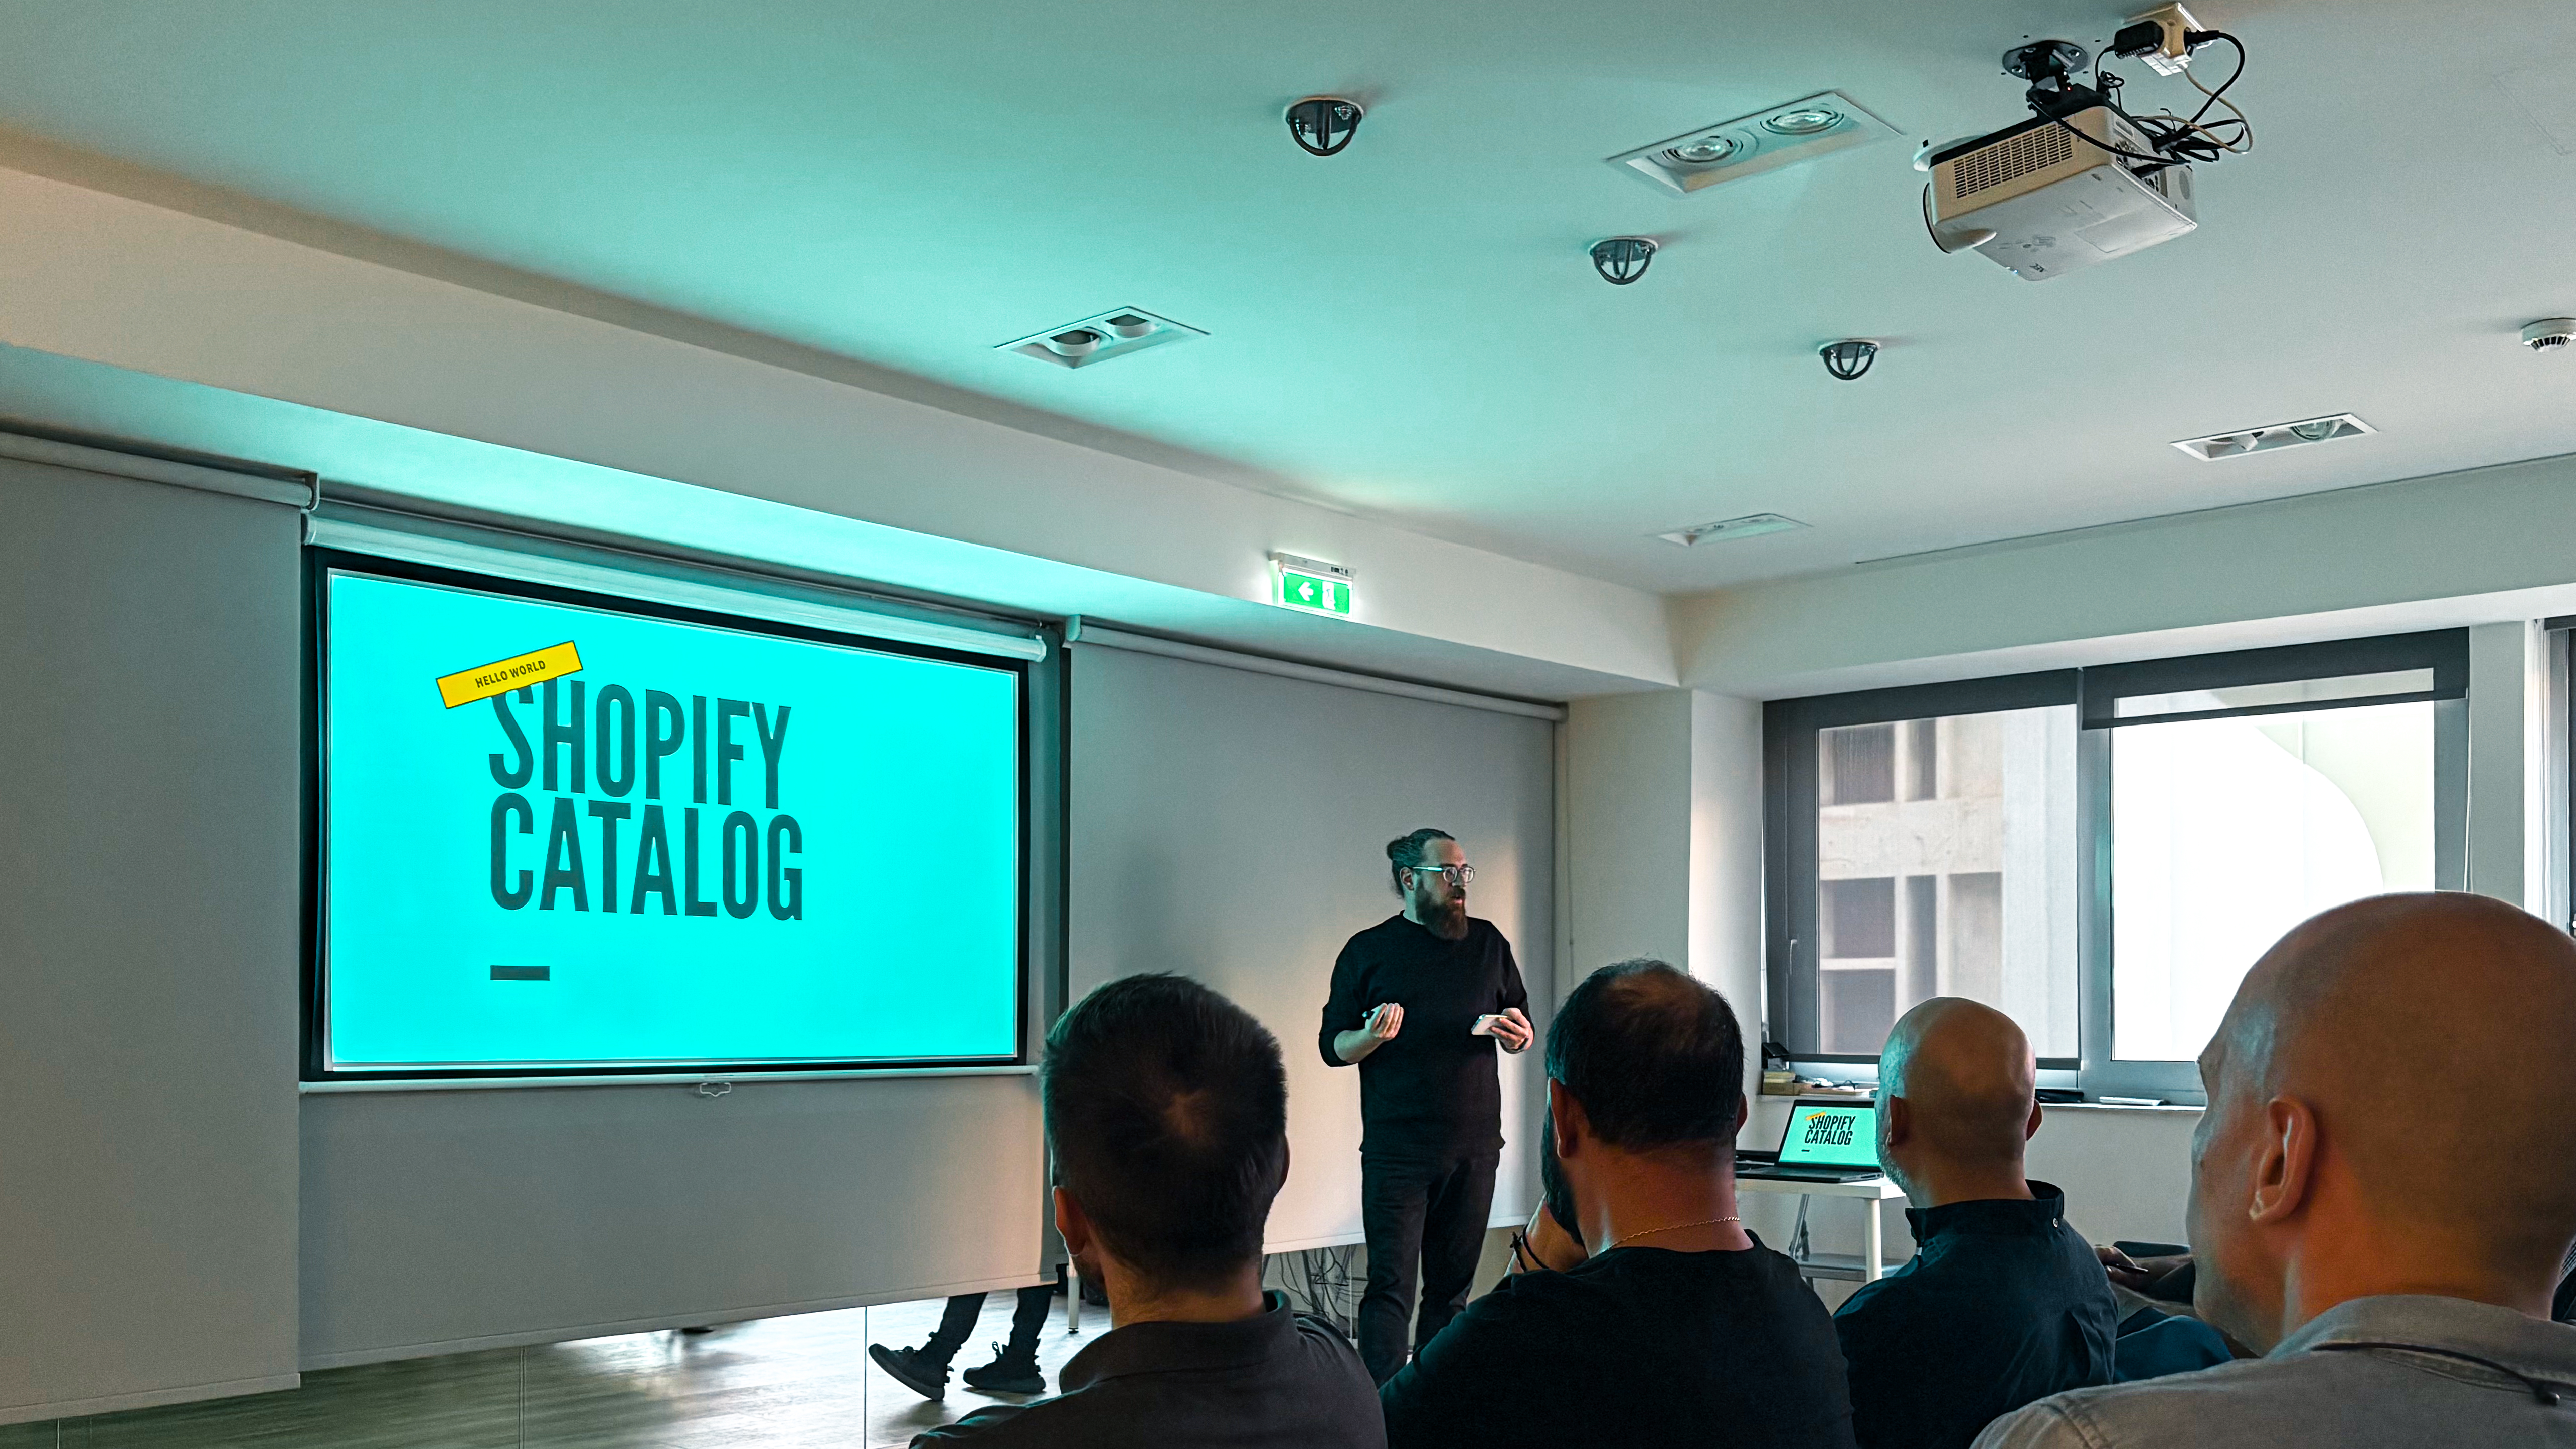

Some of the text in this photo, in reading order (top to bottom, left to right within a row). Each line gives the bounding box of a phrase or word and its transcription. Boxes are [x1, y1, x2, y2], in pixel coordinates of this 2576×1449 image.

[475, 660, 546, 688] HELLO WORLD
[488, 678, 791, 810] SHOPIFY
[490, 792, 803, 921] CATALOG
[1808, 1115, 1856, 1130] SHOPIFY
[1804, 1129, 1853, 1145] CATALOG
